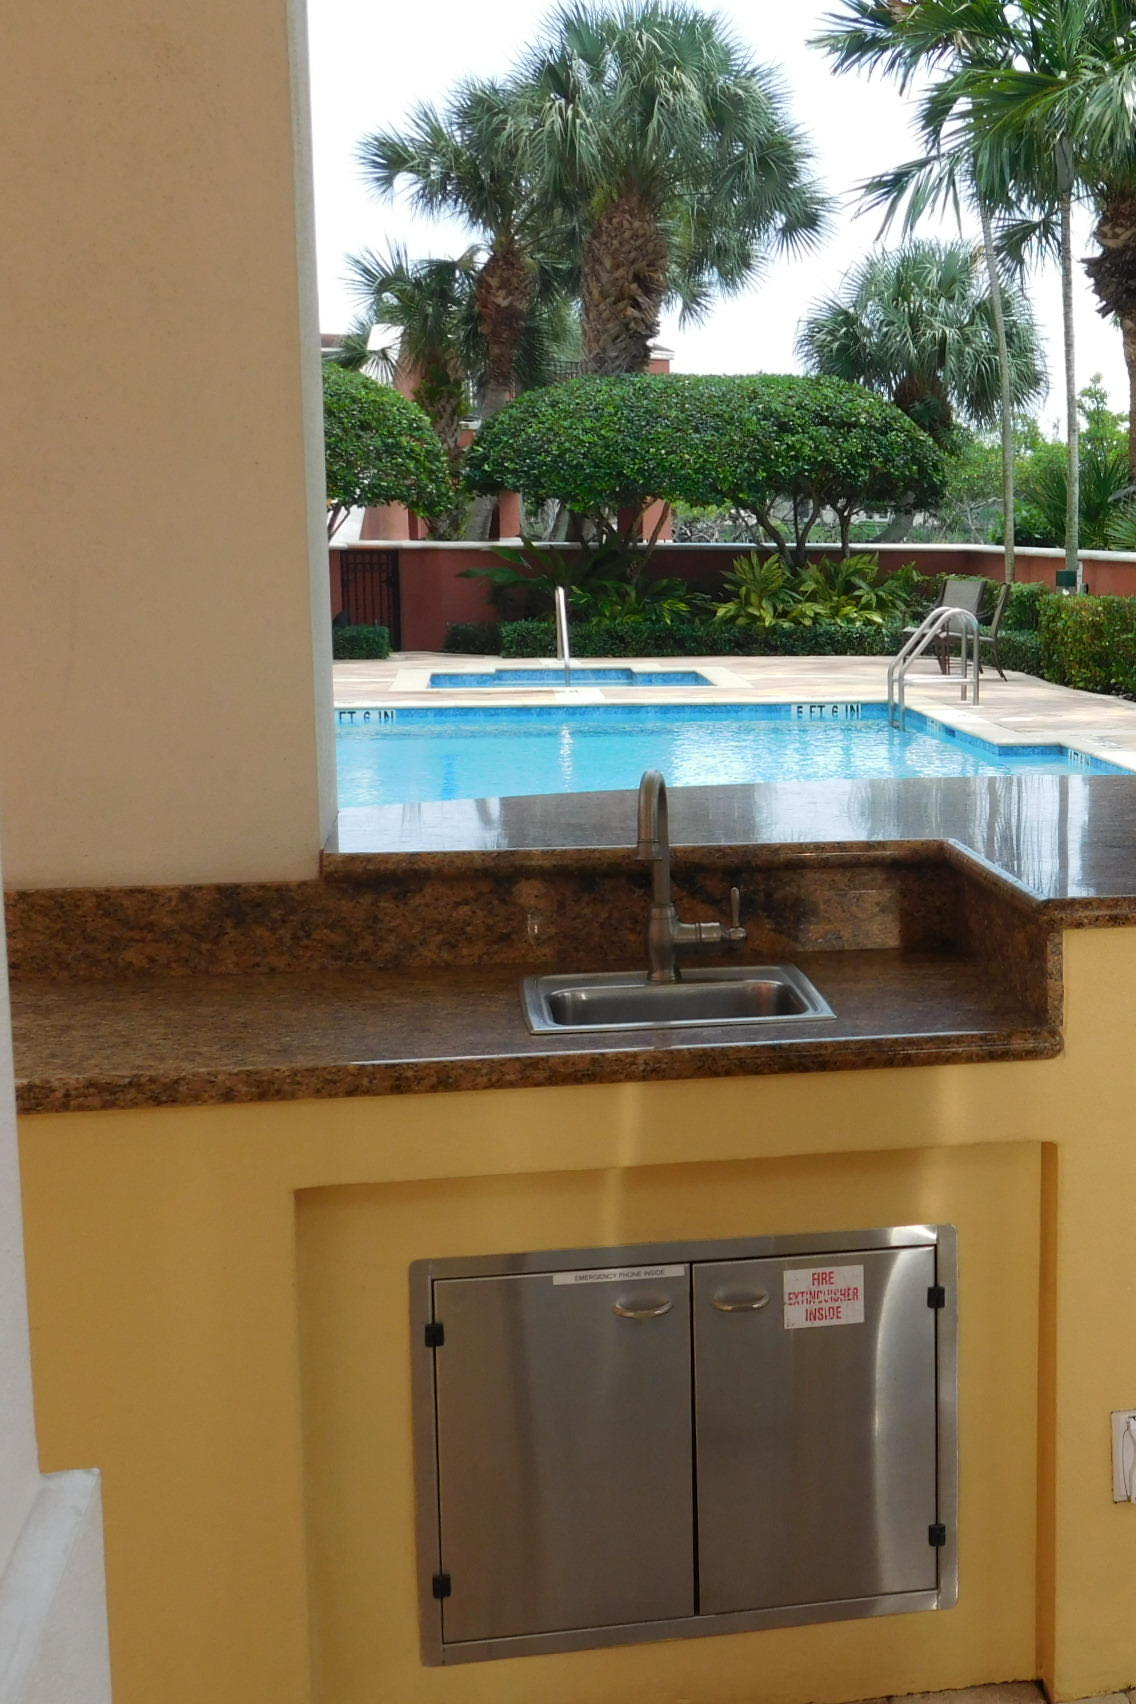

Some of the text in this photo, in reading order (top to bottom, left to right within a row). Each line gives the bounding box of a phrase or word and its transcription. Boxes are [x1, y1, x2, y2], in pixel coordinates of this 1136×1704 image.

[809, 704, 826, 720] FT
[845, 703, 860, 720] IN
[574, 1272, 616, 1281] EMERGENCY
[618, 1270, 642, 1279] PHONE
[811, 1271, 835, 1287] FIRE
[787, 1287, 859, 1306] EXTINGUISHER
[805, 1305, 842, 1322] INSIDE
